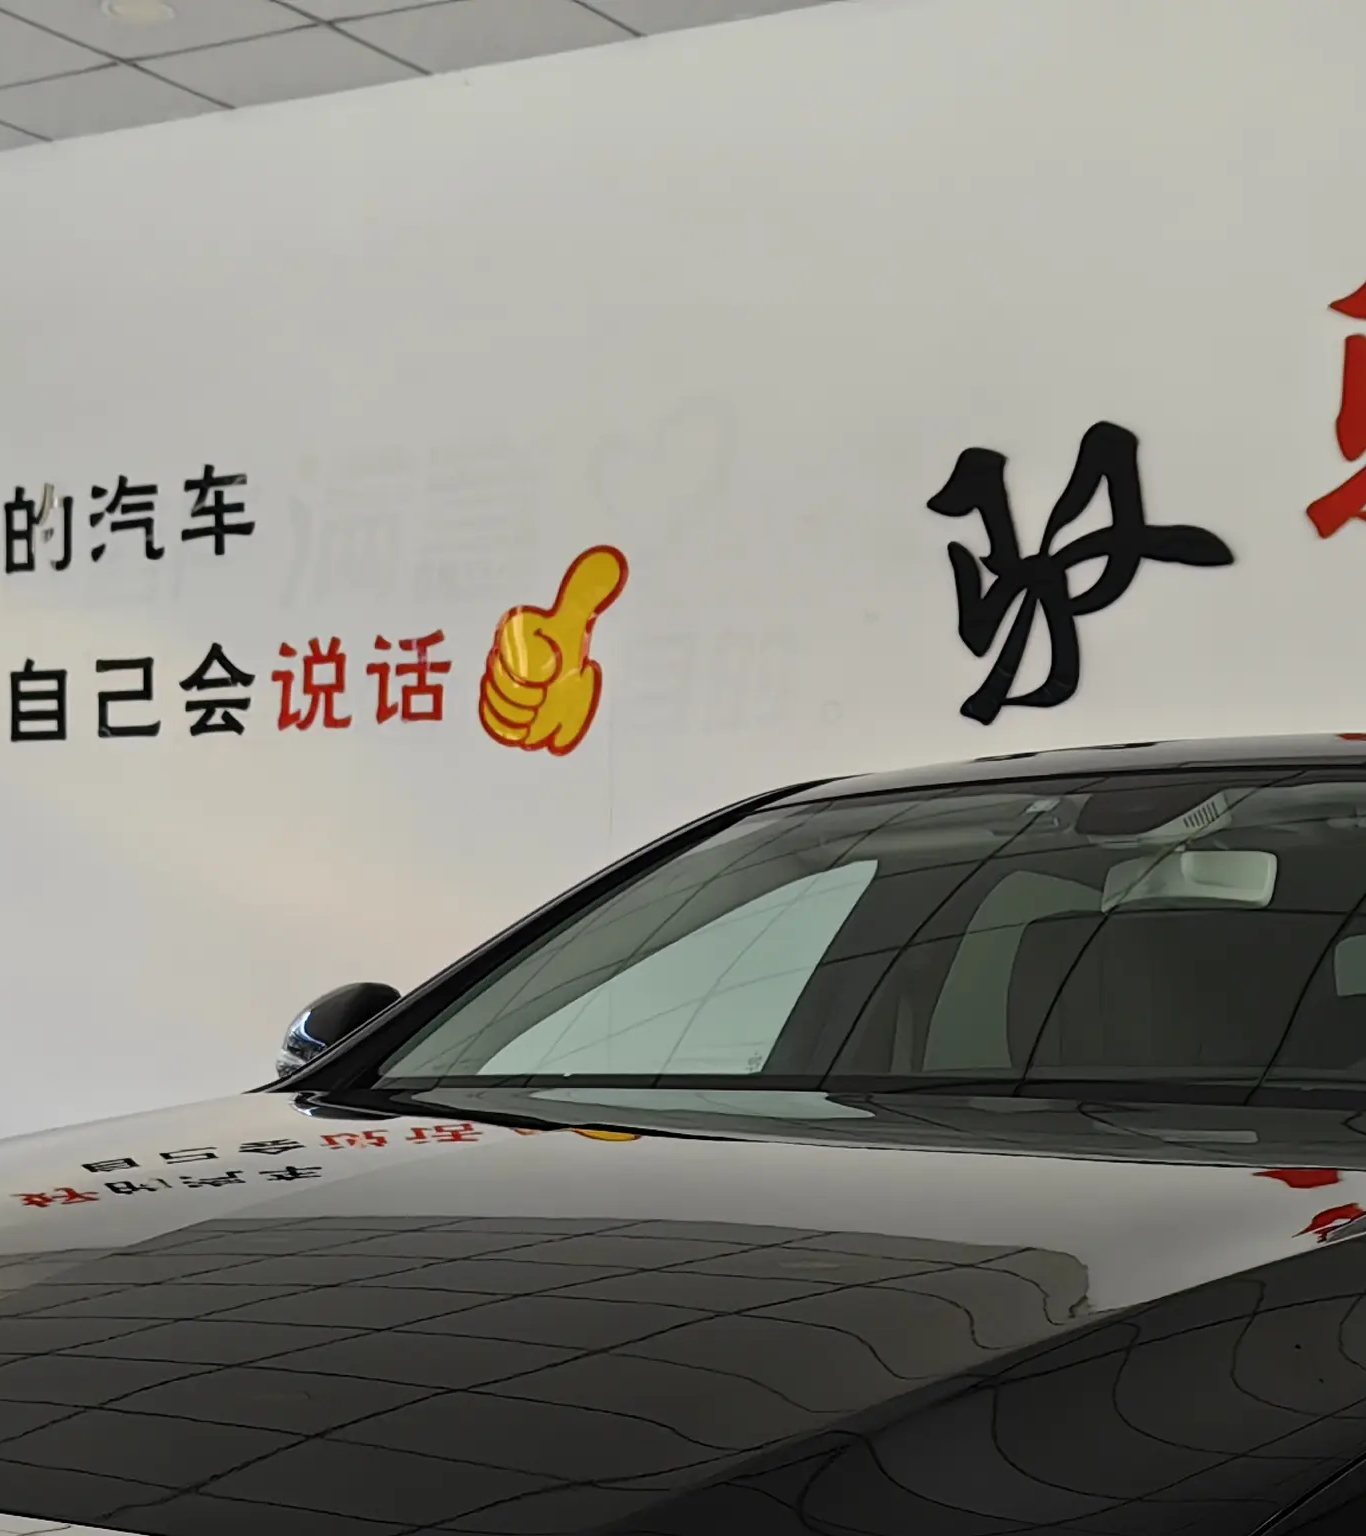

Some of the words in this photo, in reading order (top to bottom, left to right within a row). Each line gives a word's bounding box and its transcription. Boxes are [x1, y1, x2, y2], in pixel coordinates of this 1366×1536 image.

[9, 629, 453, 744] 自己会说话
